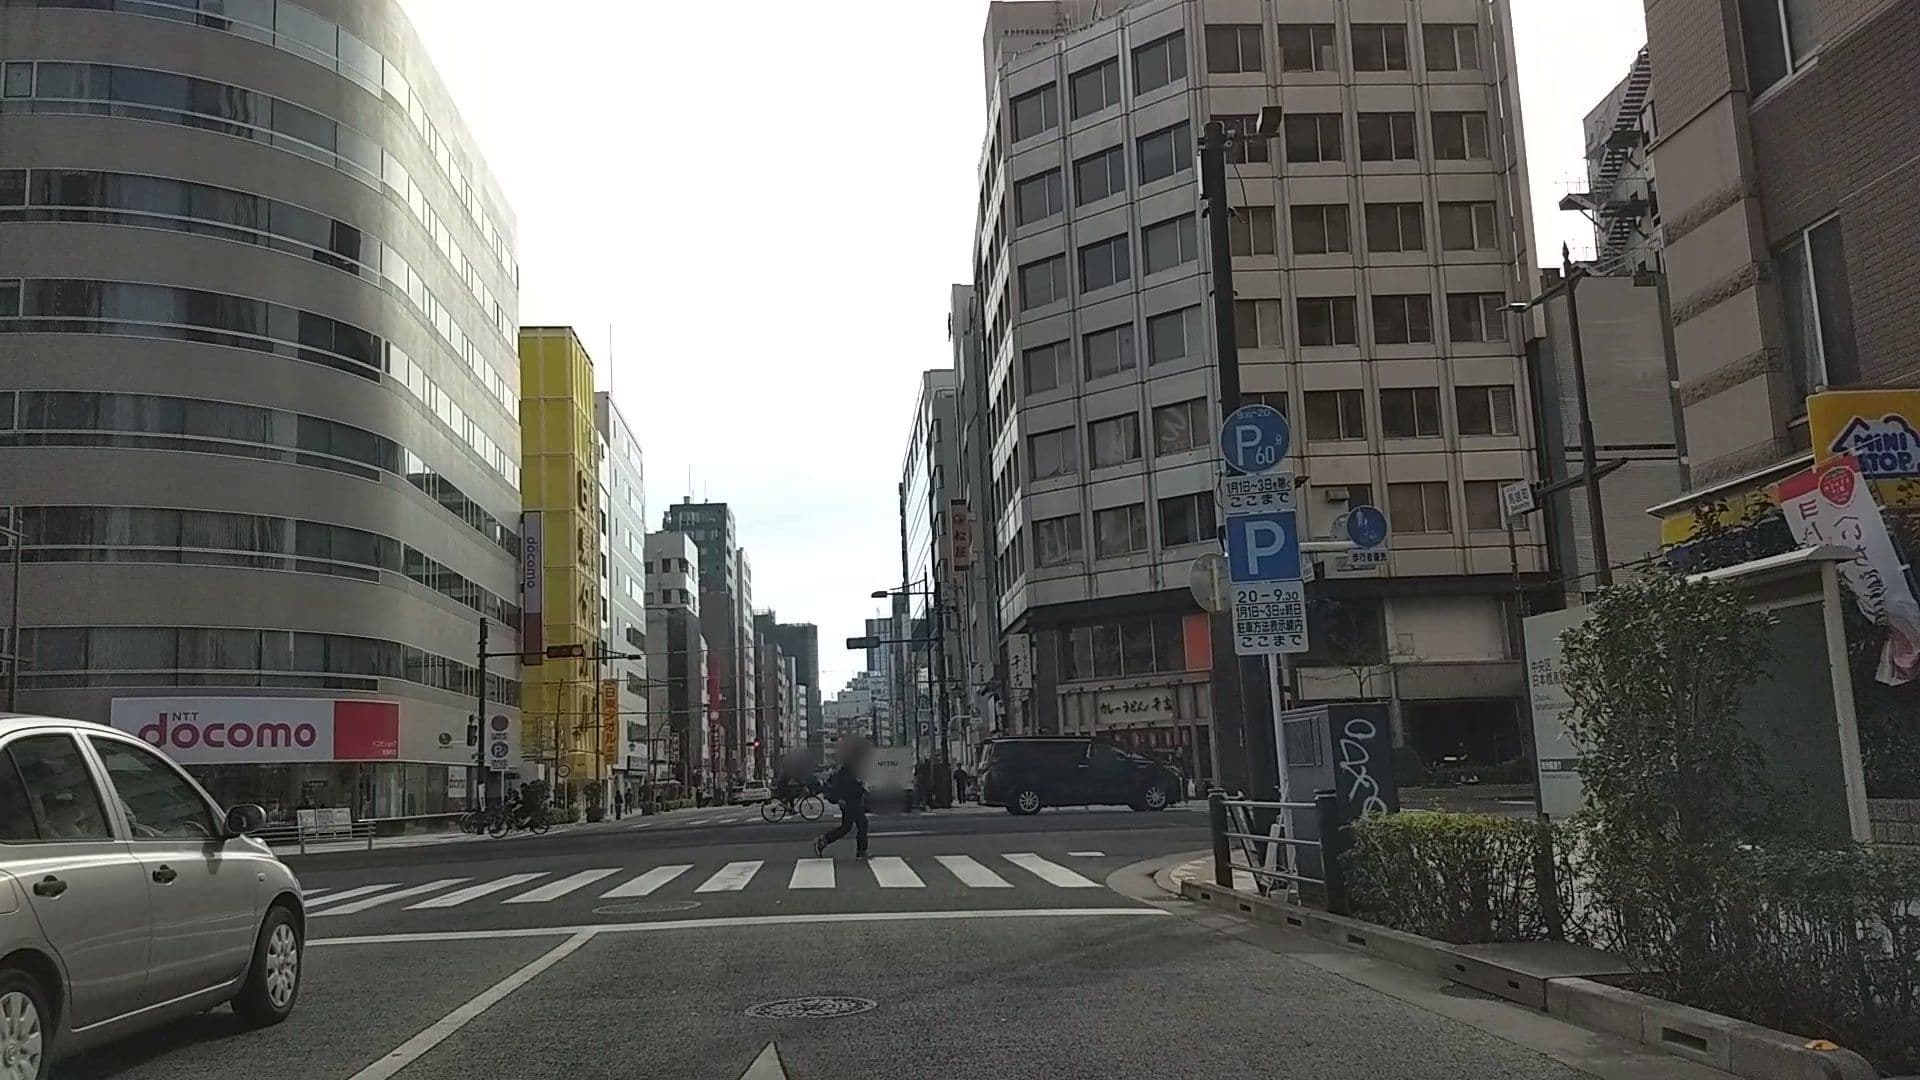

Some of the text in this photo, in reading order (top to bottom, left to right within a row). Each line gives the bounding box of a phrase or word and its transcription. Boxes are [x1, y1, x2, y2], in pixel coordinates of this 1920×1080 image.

[1235, 424, 1262, 466] P
[1854, 432, 1907, 452] MINI
[1230, 492, 1289, 508] ここまで
[1244, 519, 1286, 575] P
[527, 536, 539, 589] docomo
[1241, 634, 1302, 648] ここまで
[172, 712, 200, 721] NTT
[1100, 700, 1149, 714] カレーうどん
[138, 713, 317, 749] docomo
